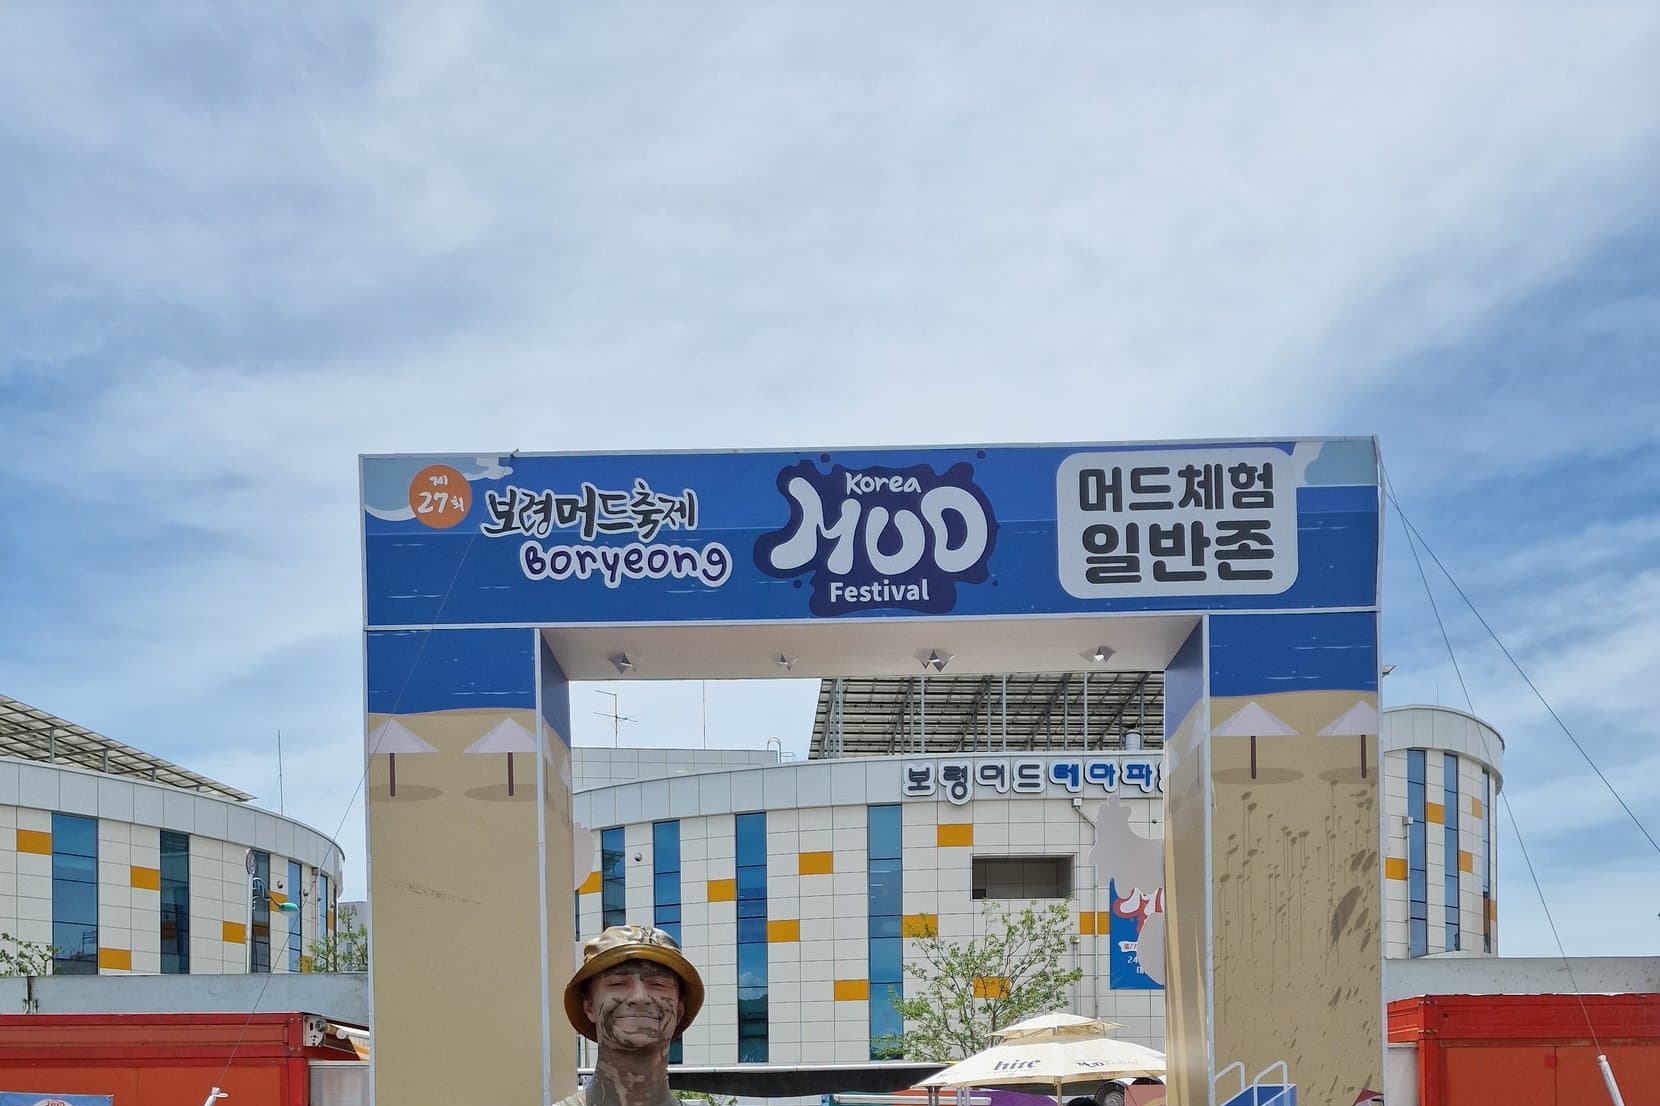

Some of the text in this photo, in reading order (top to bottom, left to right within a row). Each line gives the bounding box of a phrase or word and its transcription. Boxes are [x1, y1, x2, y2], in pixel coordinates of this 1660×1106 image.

[845, 472, 921, 495] Korea
[1078, 461, 1275, 513] 머드체험
[482, 480, 697, 540] 보령머드축제
[770, 477, 988, 576] MUD
[523, 544, 730, 584] Boryeong
[1080, 518, 1276, 585] 일반존
[829, 578, 930, 604] Festival
[907, 762, 1163, 801] 보령머드테마파
